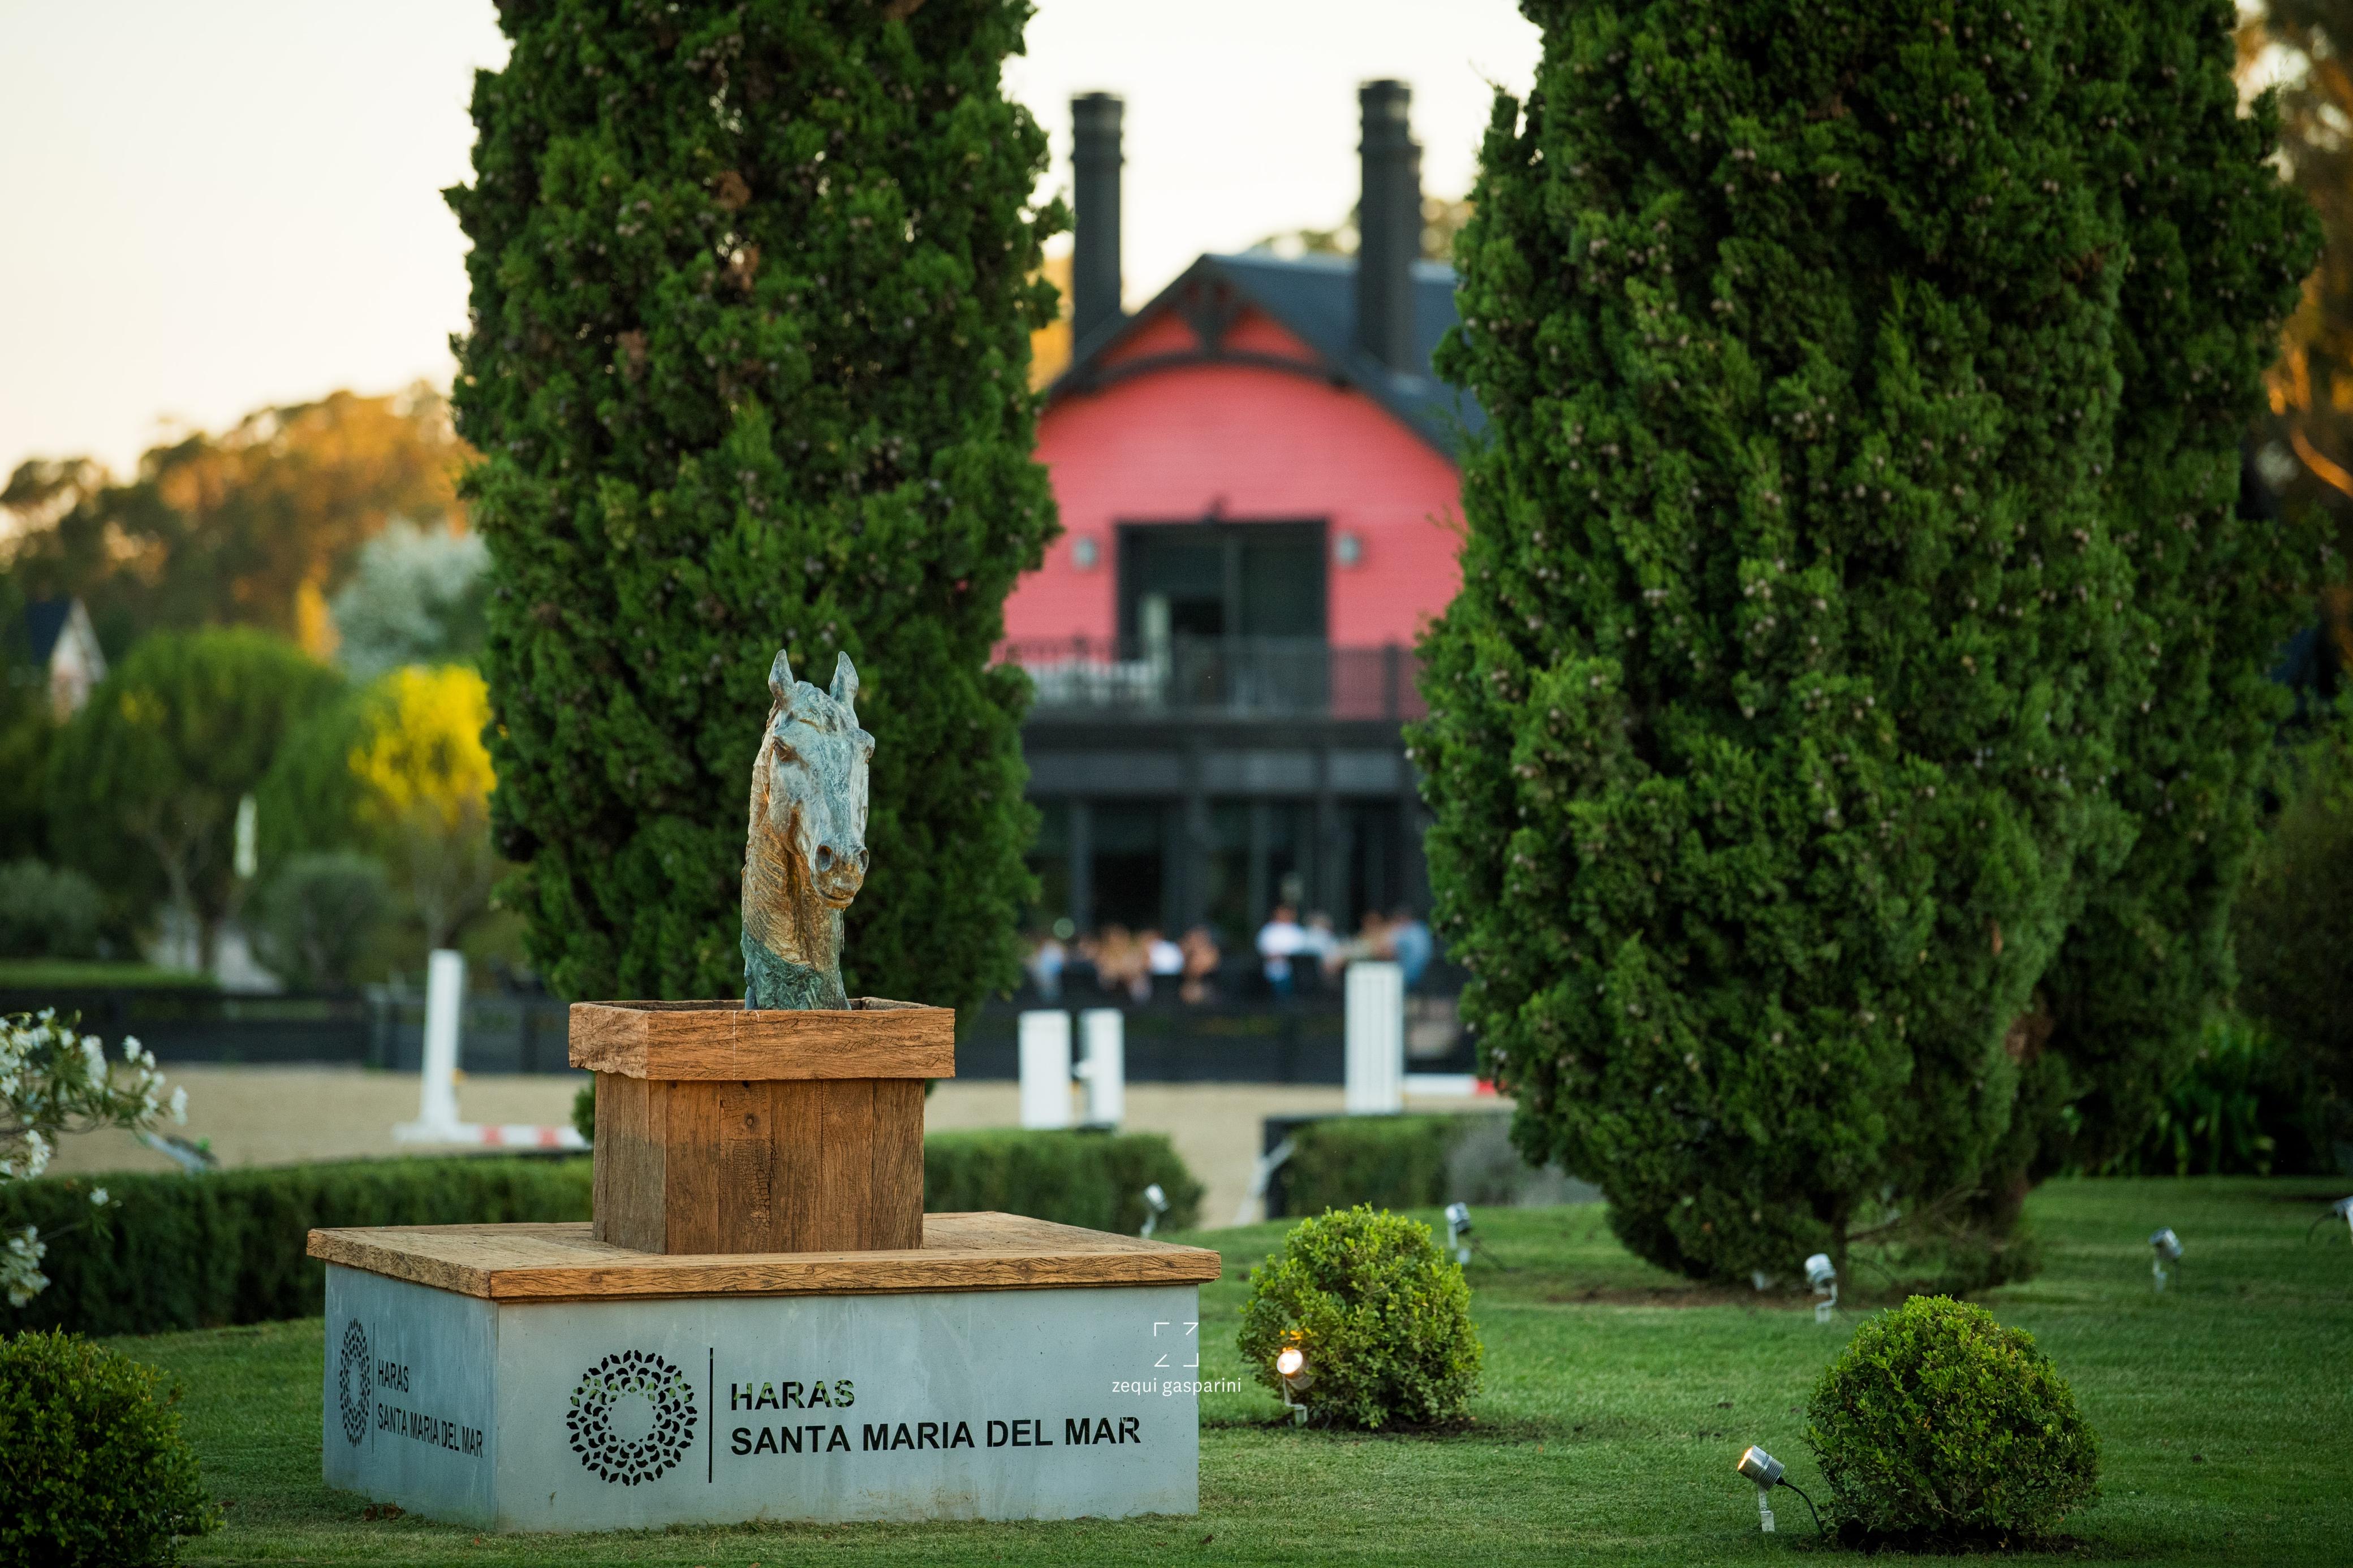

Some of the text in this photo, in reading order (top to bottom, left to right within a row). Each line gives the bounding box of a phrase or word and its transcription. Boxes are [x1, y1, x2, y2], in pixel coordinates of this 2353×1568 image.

[378, 1359, 408, 1393] HARAS
[731, 1380, 855, 1410] HARAS
[378, 1403, 482, 1458] SANTA MARIA DEL MAR
[731, 1416, 1141, 1455] SANTA MARIA DEL MAR
